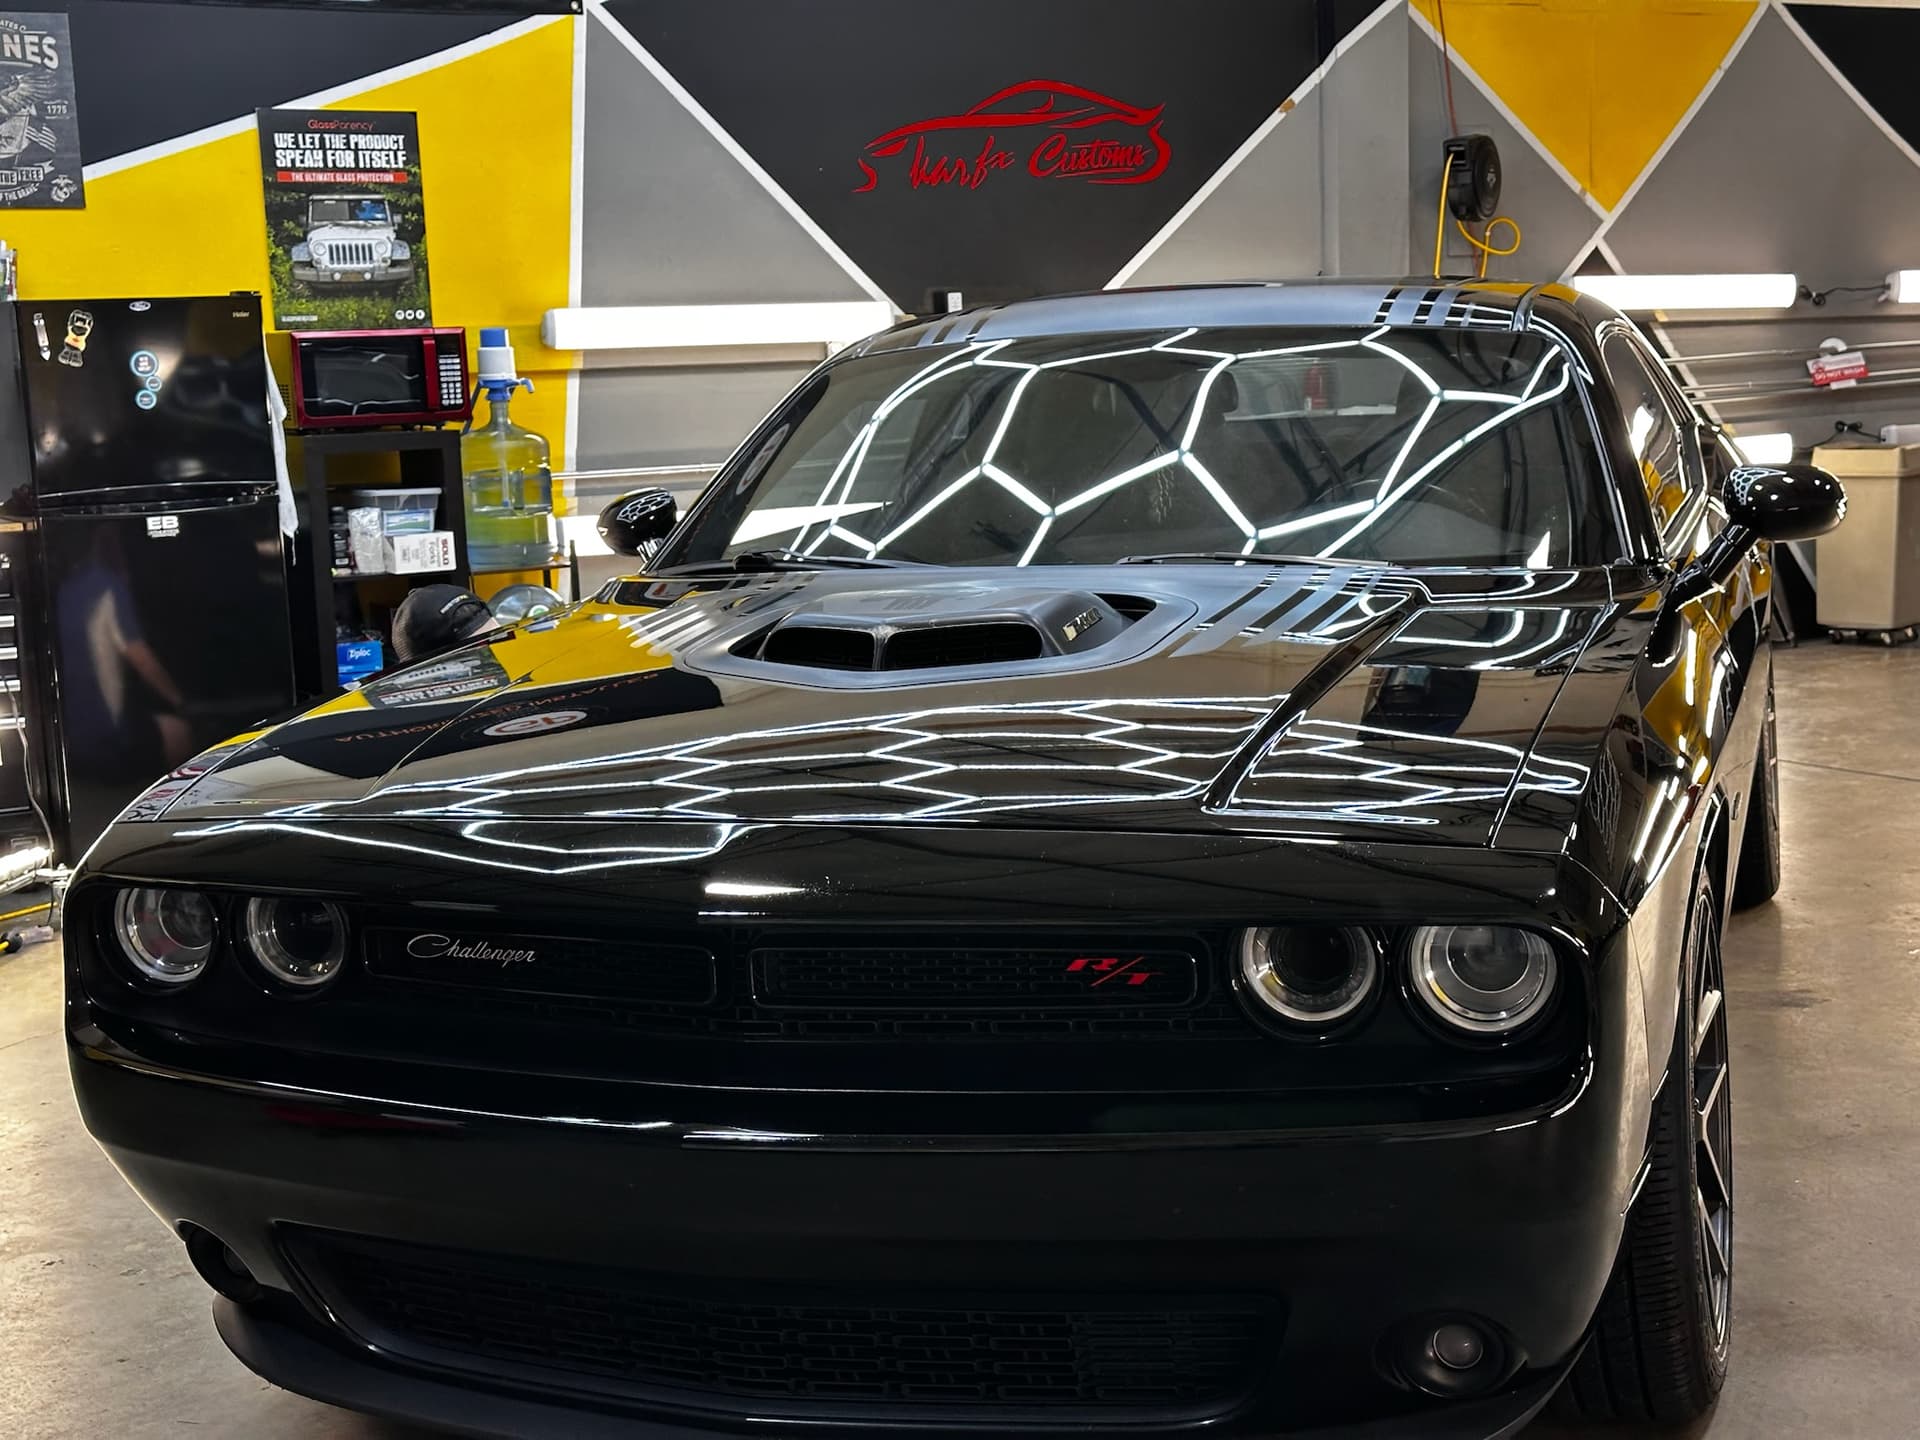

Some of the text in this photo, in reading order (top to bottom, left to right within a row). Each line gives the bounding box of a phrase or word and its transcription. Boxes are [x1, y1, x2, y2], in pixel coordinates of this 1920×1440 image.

[273, 133, 405, 150] WE LET THE PRODUCT
[274, 149, 407, 169] SPEAK FOR ITSELF
[1028, 133, 1153, 178] Customs
[291, 171, 304, 181] THE
[335, 171, 356, 182] GLASS
[146, 515, 179, 530] EB
[440, 537, 450, 566] SOLO
[406, 933, 536, 968] Challenger
[1066, 956, 1163, 987] R/T
